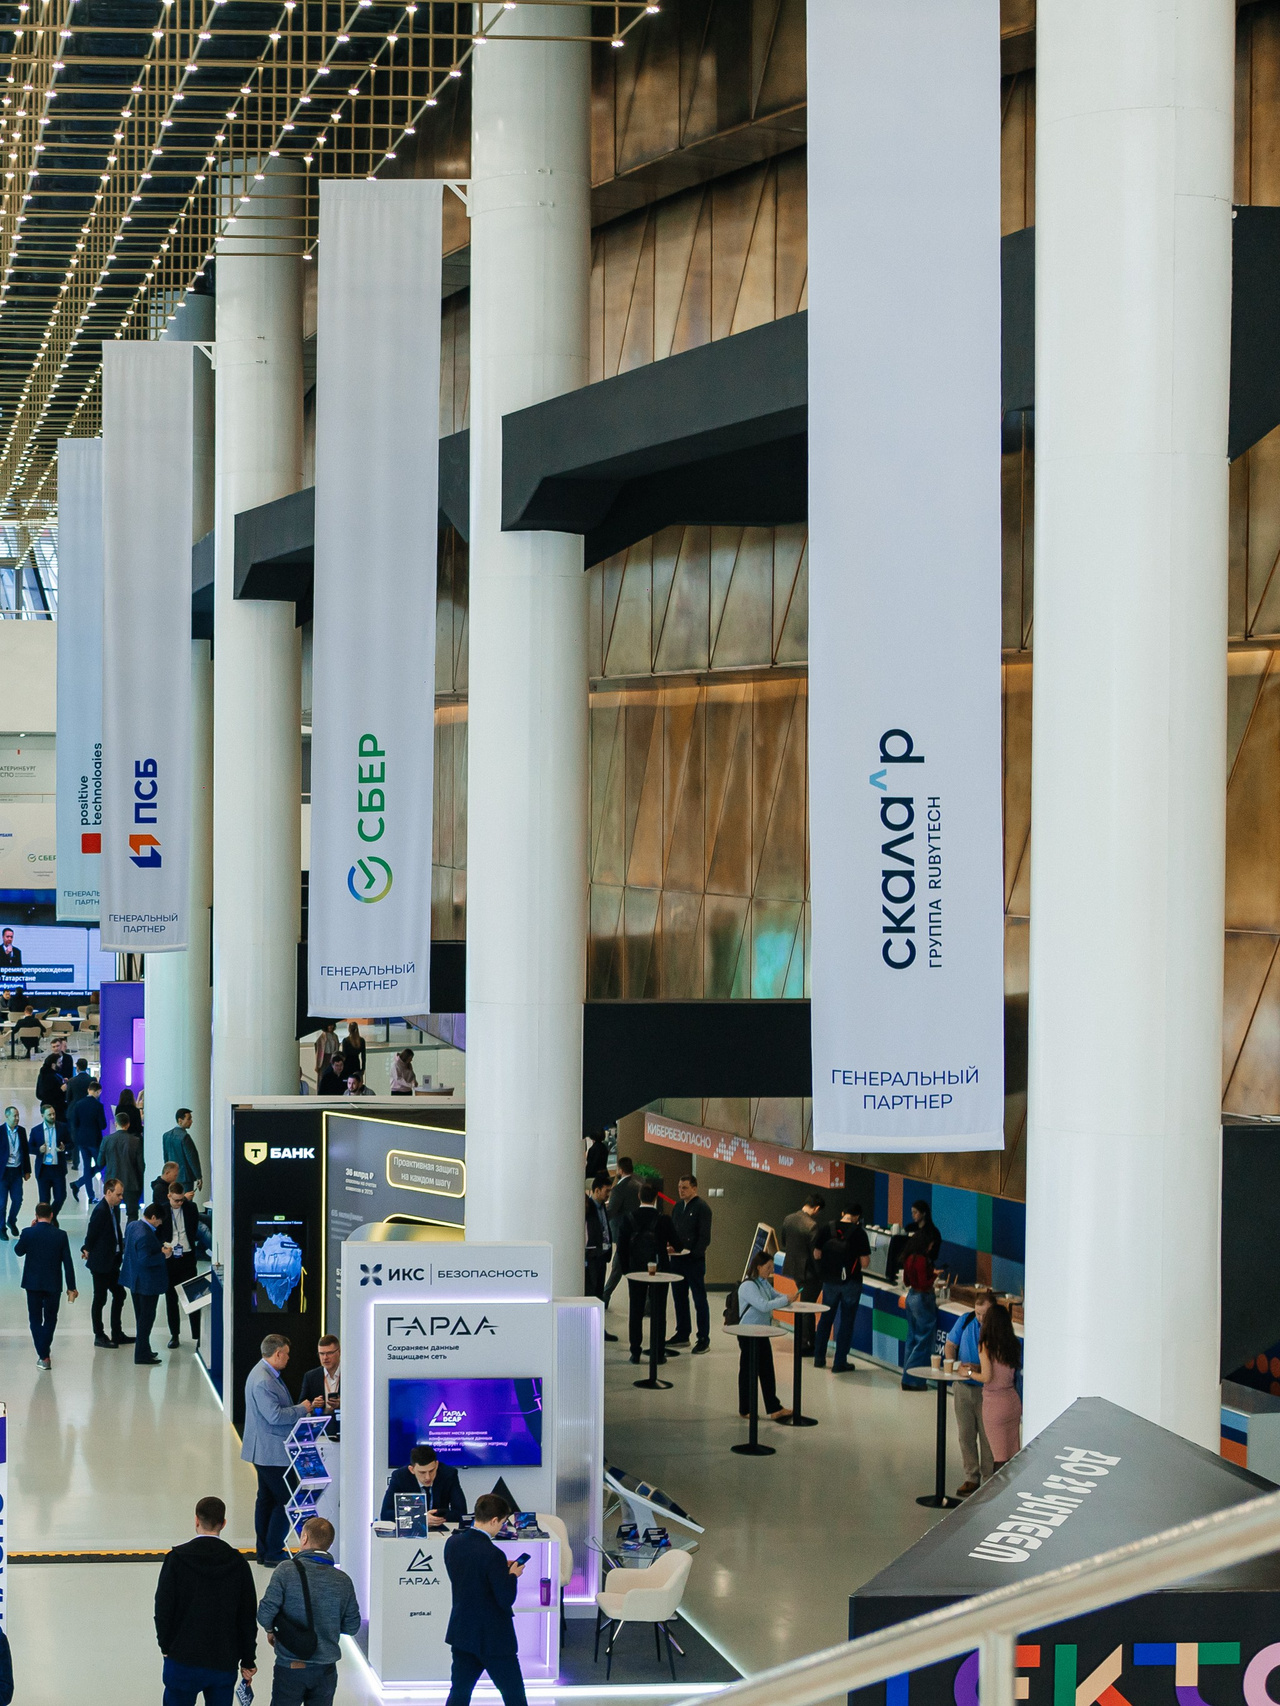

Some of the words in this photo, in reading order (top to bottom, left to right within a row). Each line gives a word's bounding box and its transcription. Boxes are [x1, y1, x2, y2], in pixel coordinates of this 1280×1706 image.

[91, 742, 102, 826] technologies
[134, 758, 158, 824] ПСБ
[357, 733, 386, 843] СБЕР
[78, 775, 91, 826] positive
[927, 796, 942, 889] RUBYTECH
[108, 912, 179, 923] ГЕНЕРАЛЬНЫЙ
[123, 925, 166, 934] ПАРТНЕР
[929, 898, 942, 968] ГРУППА
[320, 961, 416, 977] ГЕНЕРАЛЬНЫЙ
[340, 979, 399, 992] ПАРТНЕР
[831, 1066, 980, 1086] ГЕНЕРАЛЬНЫЙ
[863, 1093, 953, 1110] ПАРТНЕР
[270, 1147, 315, 1159] БАНК
[647, 1123, 712, 1149] КИБЕРБЕЗОПАСНО
[778, 1154, 794, 1167] МИР
[393, 1156, 435, 1171] Проактивная
[435, 1164, 460, 1176] защита
[401, 1173, 410, 1181] на
[410, 1173, 434, 1186] каждом
[435, 1178, 451, 1190] шагу
[388, 1268, 425, 1281] ИКС
[437, 1269, 539, 1279] БЕЗОПАСНОСТЬ
[386, 1315, 500, 1336] ГАРДА
[387, 1344, 429, 1353] Сохраняем
[430, 1344, 460, 1353] данные
[387, 1353, 430, 1361] Защищаем
[398, 1576, 441, 1586] ГАРДА
[409, 1610, 432, 1618] garda.ai
